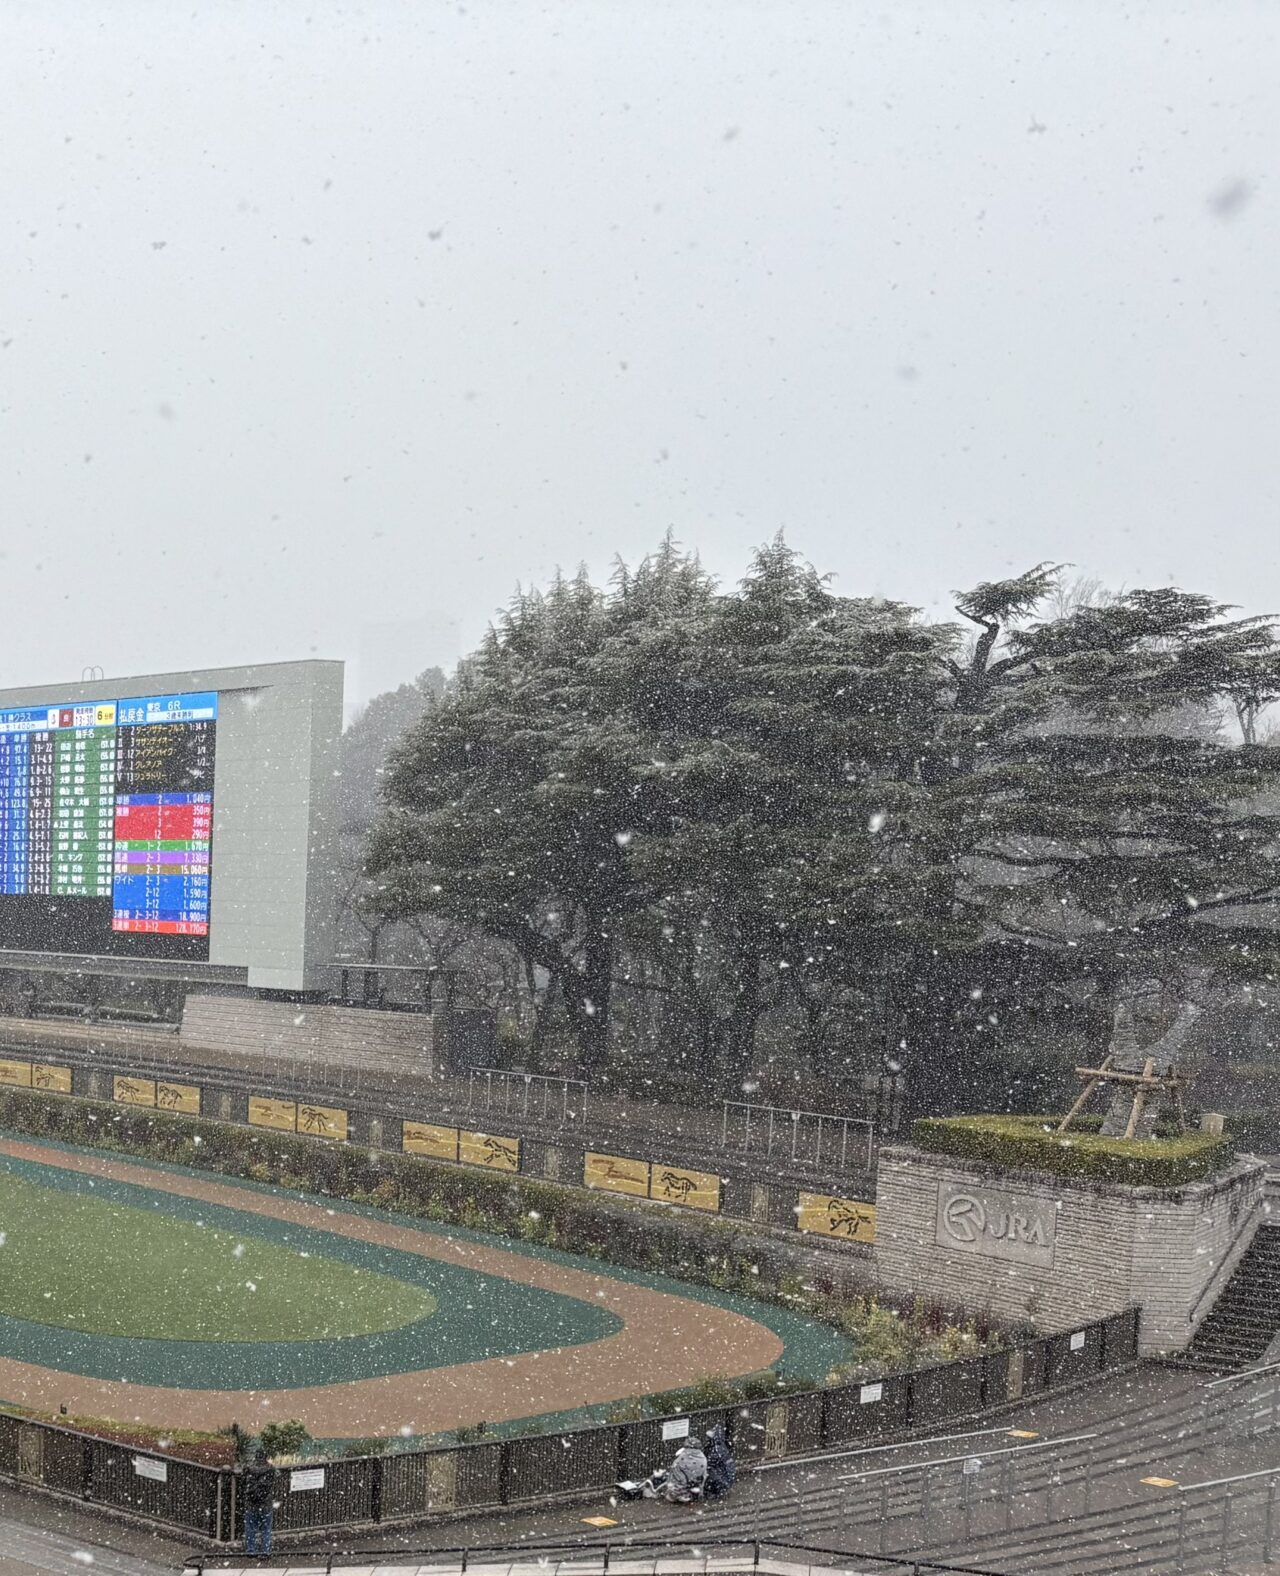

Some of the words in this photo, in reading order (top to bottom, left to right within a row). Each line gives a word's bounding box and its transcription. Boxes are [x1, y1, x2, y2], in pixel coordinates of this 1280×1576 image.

[168, 701, 180, 711] 6R
[76, 715, 94, 727] 13:30
[119, 708, 145, 724] 払戻金
[193, 805, 210, 816] 350円
[192, 829, 209, 840] 290円
[146, 865, 160, 874] 2-3
[114, 876, 134, 886] ワイド
[146, 876, 160, 886] 2-3
[146, 888, 159, 898] 2-12
[146, 899, 159, 909] 3-12
[990, 1213, 1048, 1247] JRA
